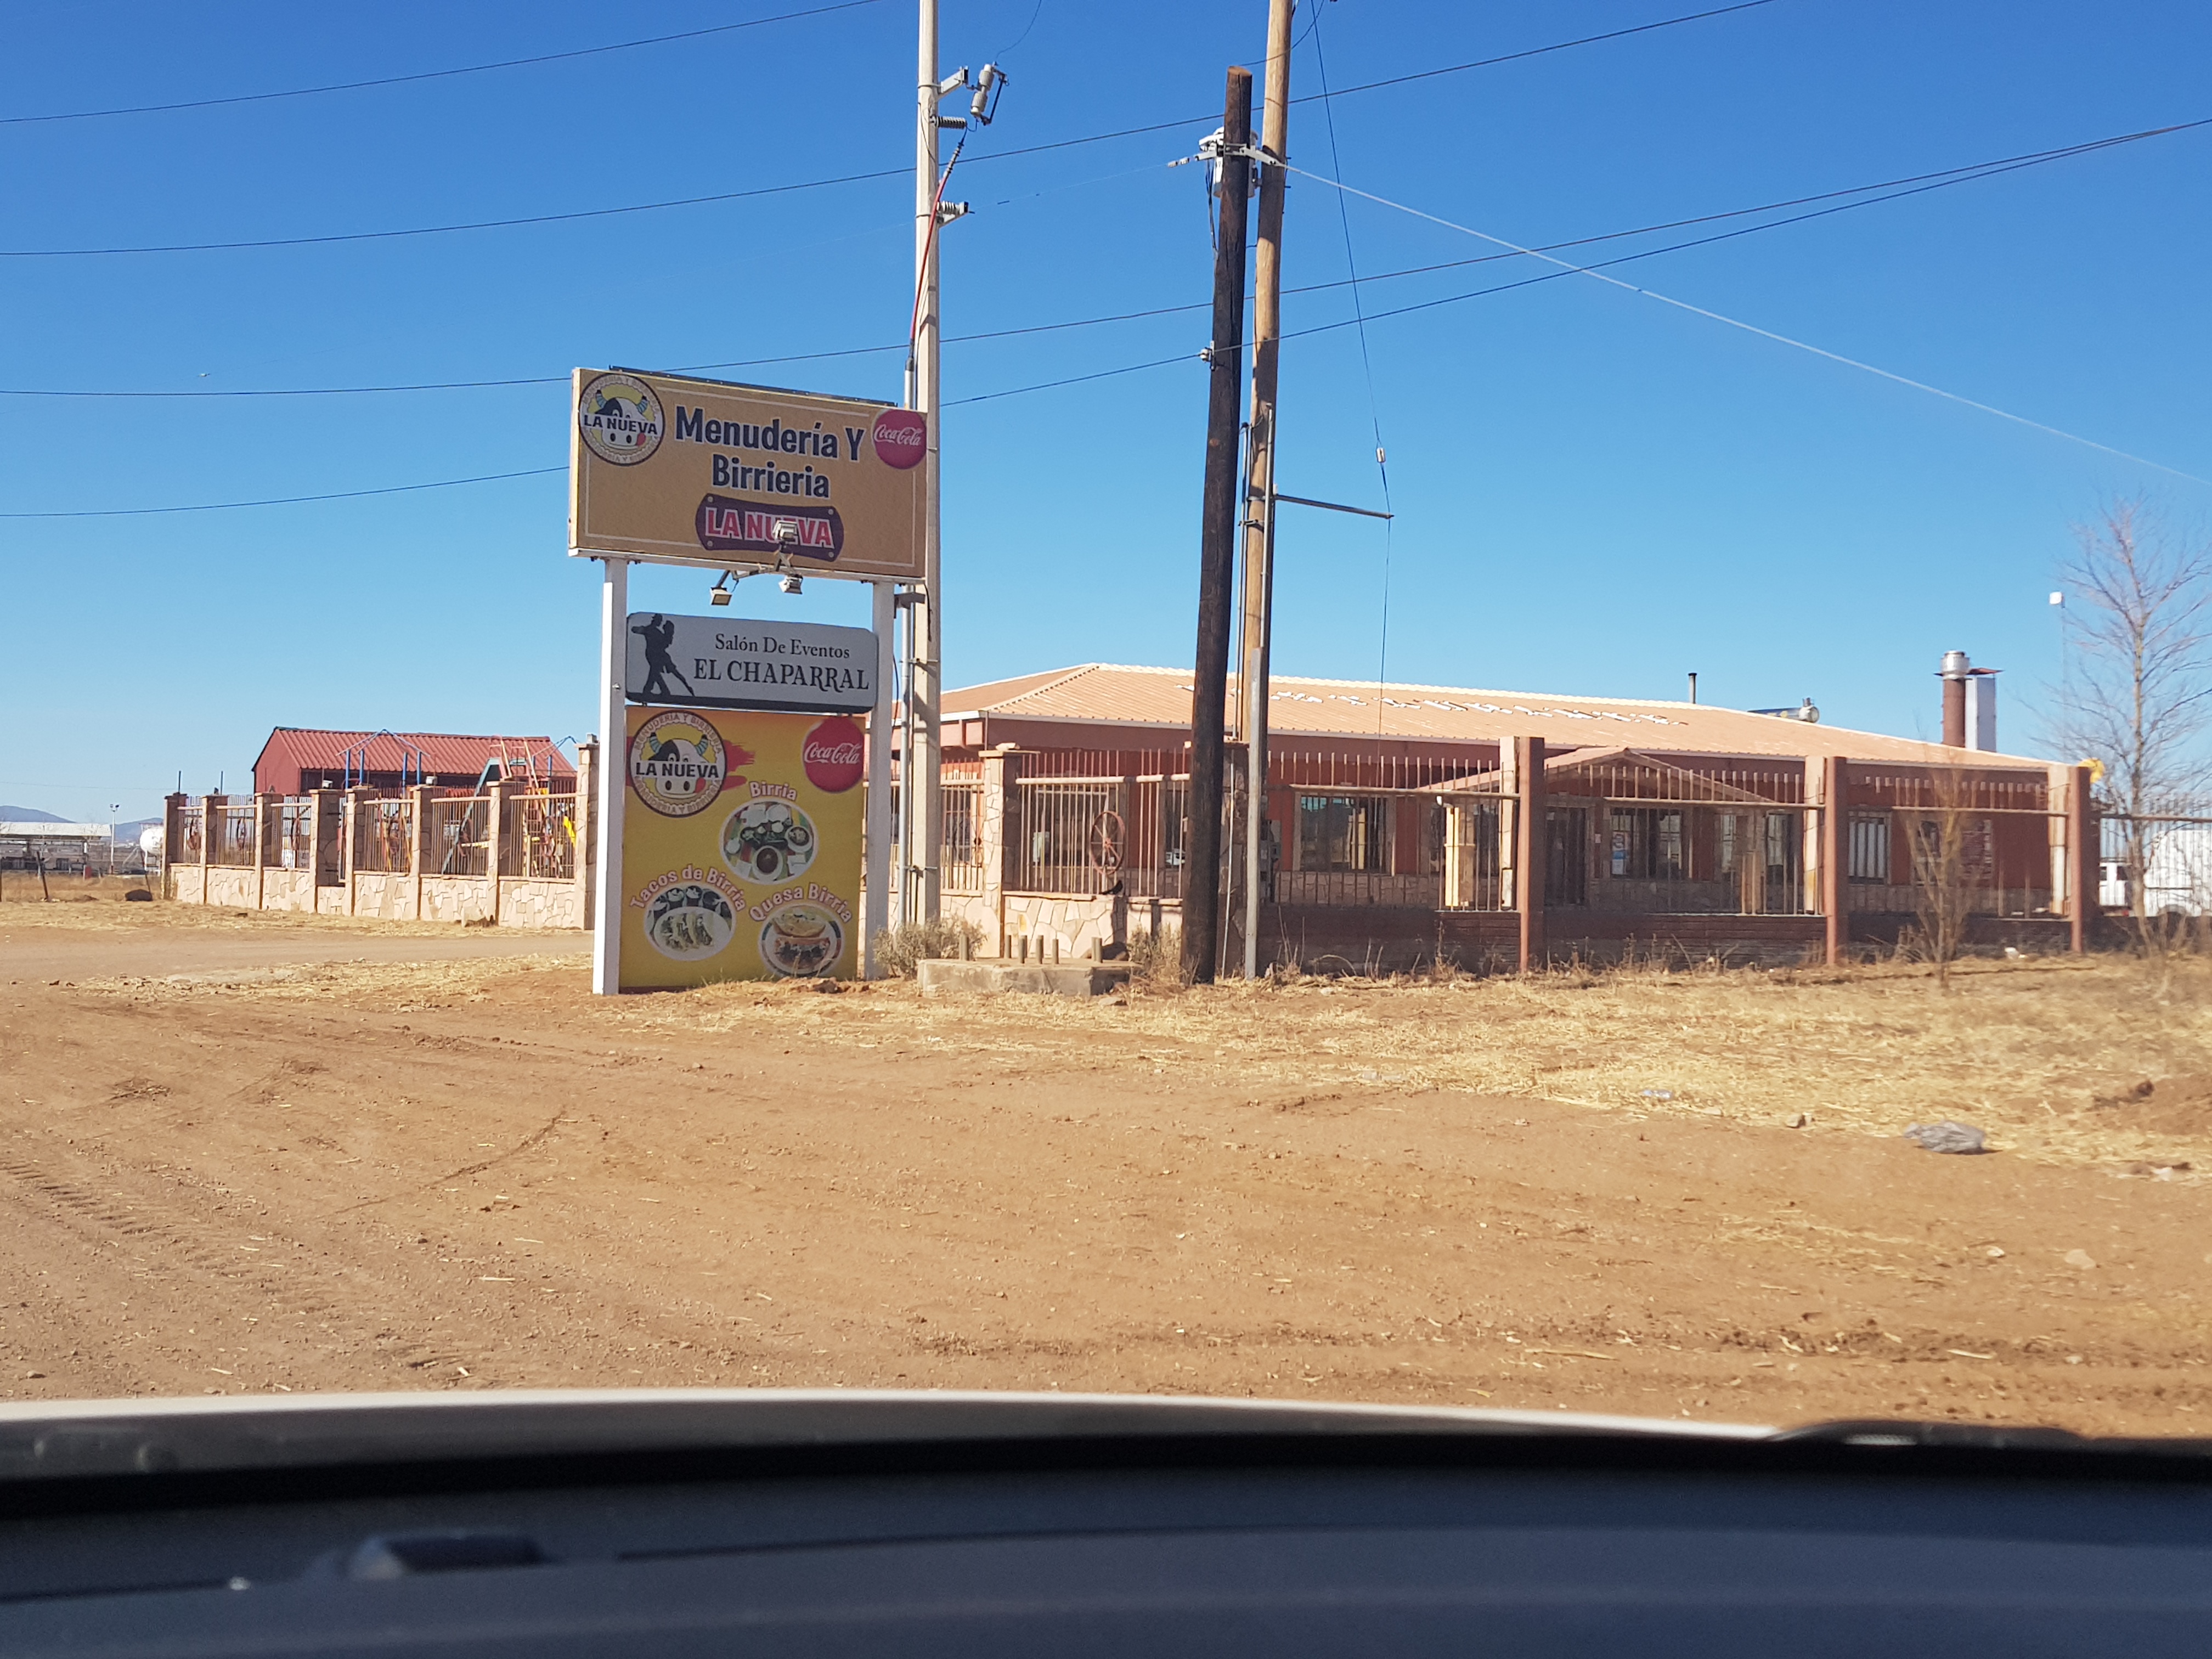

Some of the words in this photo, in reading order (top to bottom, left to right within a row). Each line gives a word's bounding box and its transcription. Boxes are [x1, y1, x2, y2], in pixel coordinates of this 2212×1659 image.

[584, 414, 603, 428] LA
[607, 417, 658, 435] NUEVA
[675, 405, 839, 459] Menudería
[845, 427, 866, 462] Y
[874, 424, 922, 446] Coca-Cola
[712, 454, 831, 498] Birrieria
[706, 506, 742, 539] LA
[714, 633, 758, 653] Salón
[763, 636, 786, 654] De
[790, 639, 850, 659] Eventos
[693, 658, 721, 681] EL
[727, 659, 870, 693] CHAPARRAL
[804, 742, 862, 764] Coca-Cola
[635, 762, 657, 776] LA
[662, 763, 719, 778] NUEVA
[748, 780, 798, 802] Birria
[630, 870, 679, 909] Tacos
[681, 864, 703, 881] de
[706, 866, 746, 912] Birria
[749, 886, 804, 922] Quesa
[808, 881, 853, 924] Birria
